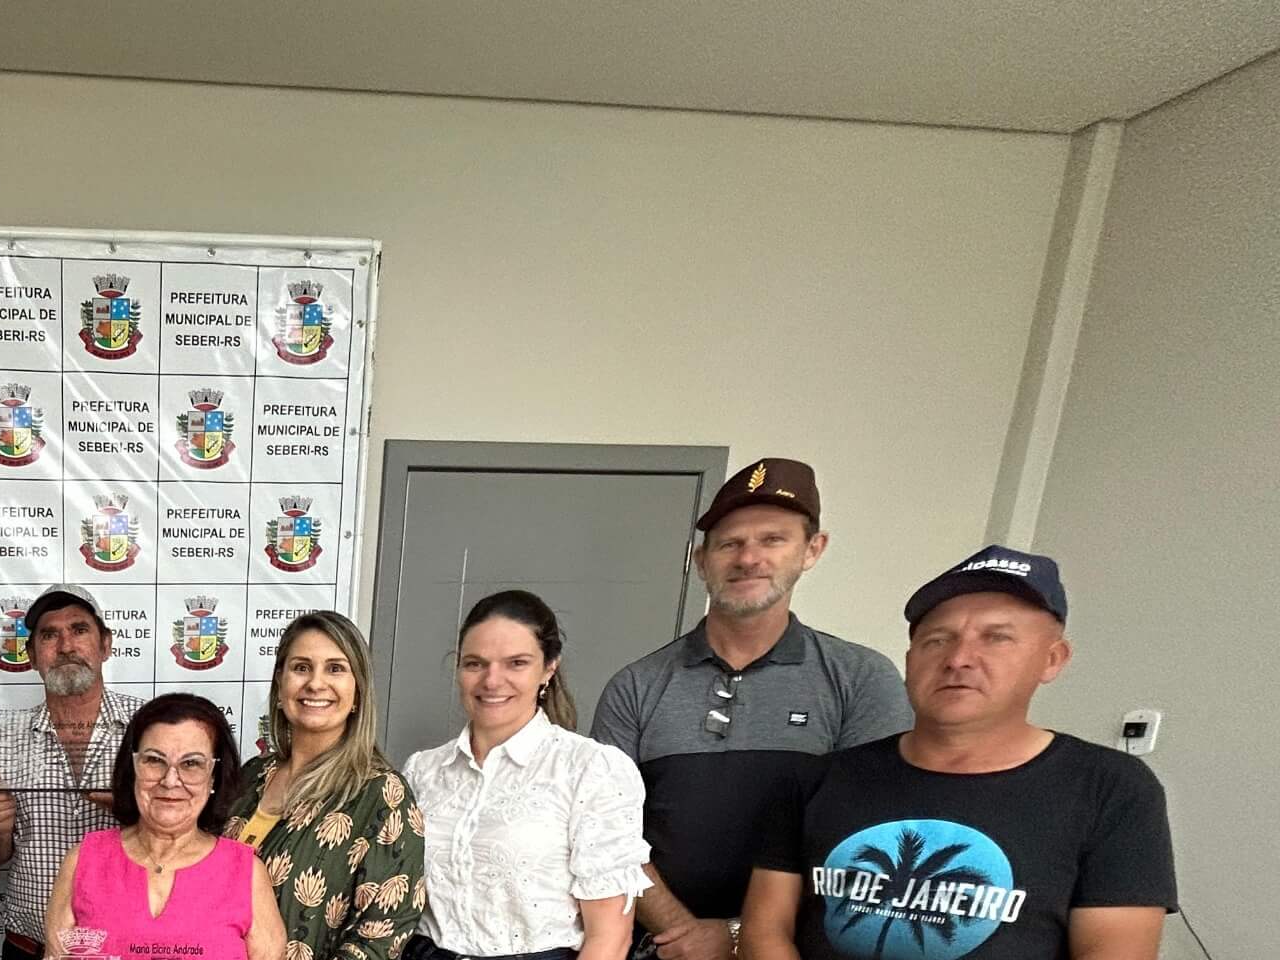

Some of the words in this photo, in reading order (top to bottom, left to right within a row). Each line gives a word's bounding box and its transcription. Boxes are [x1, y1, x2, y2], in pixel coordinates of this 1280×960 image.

[170, 292, 248, 306] PREFEITURA
[39, 309, 57, 321] DE
[165, 315, 232, 326] MUNICIPAL
[235, 315, 252, 327] DE
[175, 335, 241, 347] SEBERI-RS
[72, 401, 150, 413] PREFEITURA
[263, 404, 337, 417] PREFEITURA
[68, 422, 135, 433] MUNICIPAL
[138, 422, 154, 433] DE
[257, 425, 321, 437] MUNICIPAL
[323, 426, 340, 437] DE
[266, 444, 329, 456] SEBERI-RS
[166, 508, 241, 519] PREFEITURA
[42, 527, 58, 537] DE
[162, 528, 226, 539] MUNICIPAL
[228, 528, 245, 539] DE
[171, 547, 234, 558] SEBERI-RS
[104, 610, 147, 621] EITURA
[135, 628, 152, 639] DE
[812, 866, 846, 898] RIO
[848, 872, 893, 904] DE
[892, 877, 1027, 924] JANEIRO
